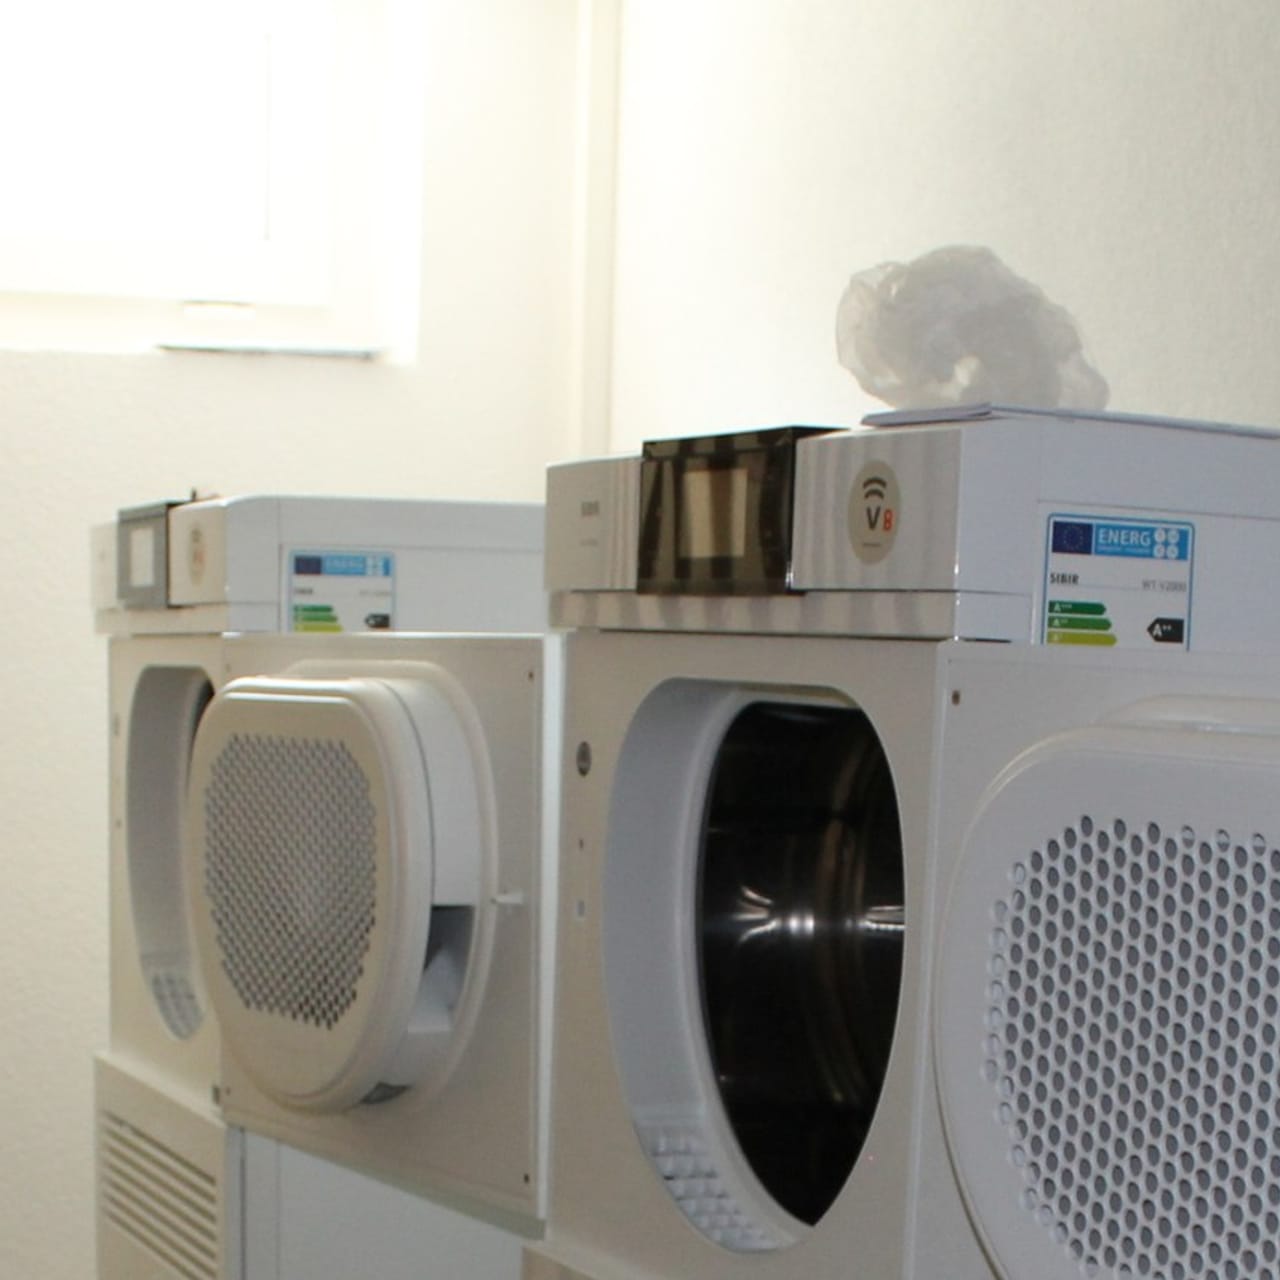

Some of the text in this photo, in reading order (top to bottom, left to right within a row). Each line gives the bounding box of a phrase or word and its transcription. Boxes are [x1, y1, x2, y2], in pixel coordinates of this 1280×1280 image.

[865, 505, 893, 532] V8
[1098, 527, 1151, 546] ENERG
[1050, 572, 1079, 585] SIBIR
